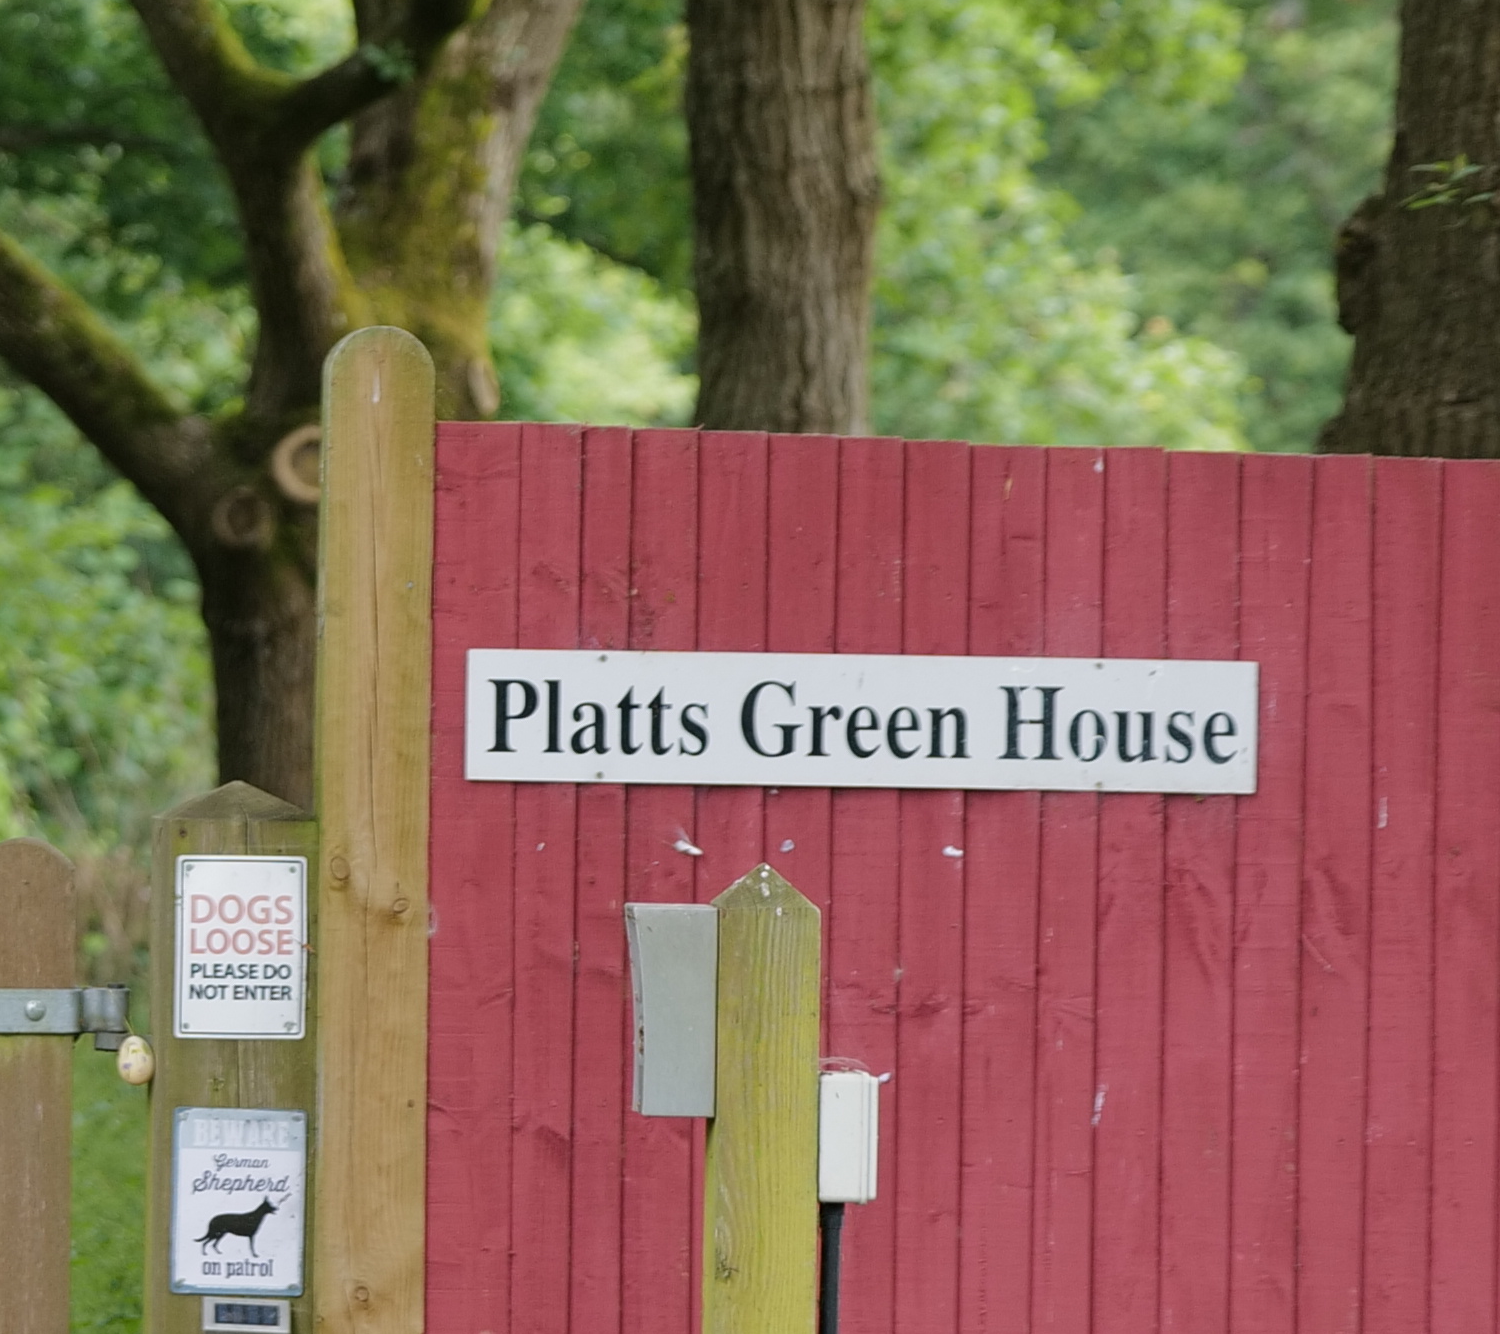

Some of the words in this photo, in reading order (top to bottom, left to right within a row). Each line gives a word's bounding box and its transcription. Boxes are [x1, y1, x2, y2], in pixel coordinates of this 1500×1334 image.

[486, 678, 711, 757] Platts
[740, 679, 972, 760] Green
[997, 685, 1238, 765] House
[190, 894, 295, 925] DOGS
[190, 928, 295, 955] LOOSE
[190, 963, 260, 979] PLEASE
[263, 964, 292, 980] DO
[188, 984, 229, 1000] NOT
[232, 985, 292, 1000] ENTER
[192, 1118, 290, 1148] BEWARE
[214, 1153, 269, 1171] German
[192, 1170, 290, 1195] Shepherd
[202, 1260, 222, 1276] on
[226, 1258, 274, 1279] patrol
